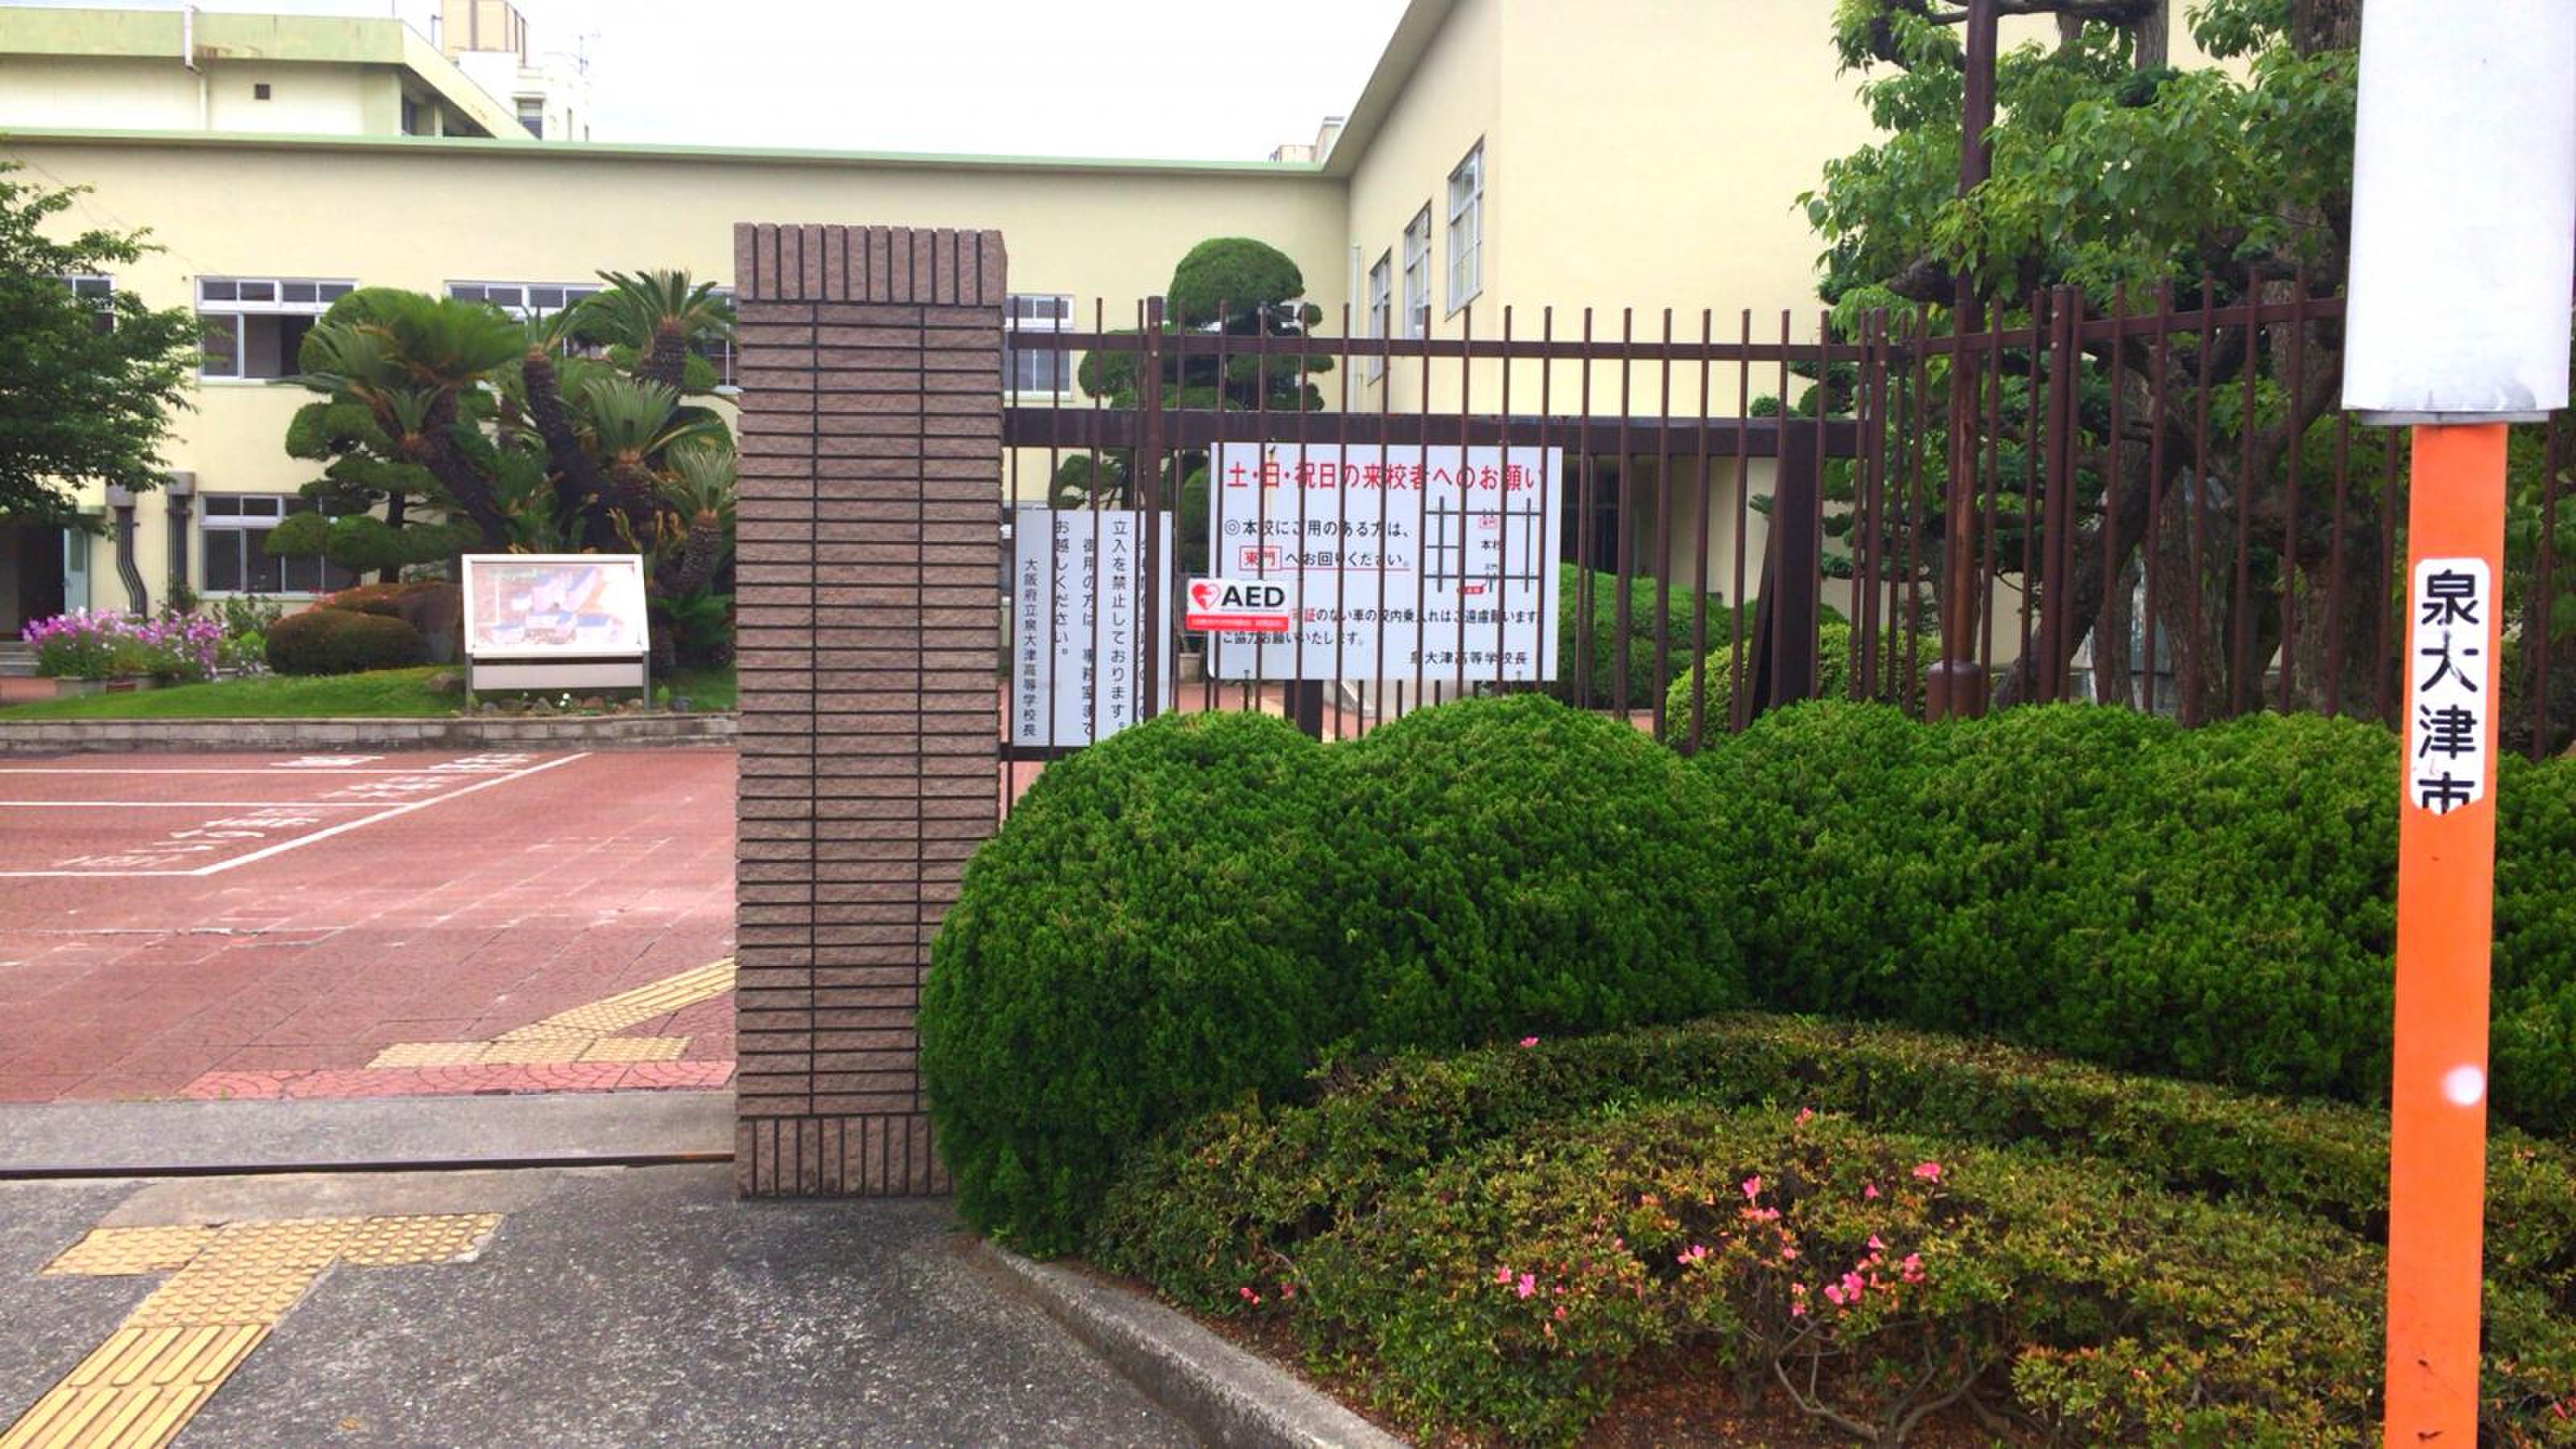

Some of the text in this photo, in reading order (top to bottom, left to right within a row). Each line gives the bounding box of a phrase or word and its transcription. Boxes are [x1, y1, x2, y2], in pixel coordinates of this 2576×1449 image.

[1111, 520, 1128, 728] 立入を禁止しております。
[1221, 585, 1286, 607] AED
[2417, 569, 2479, 815] 泉大津市
